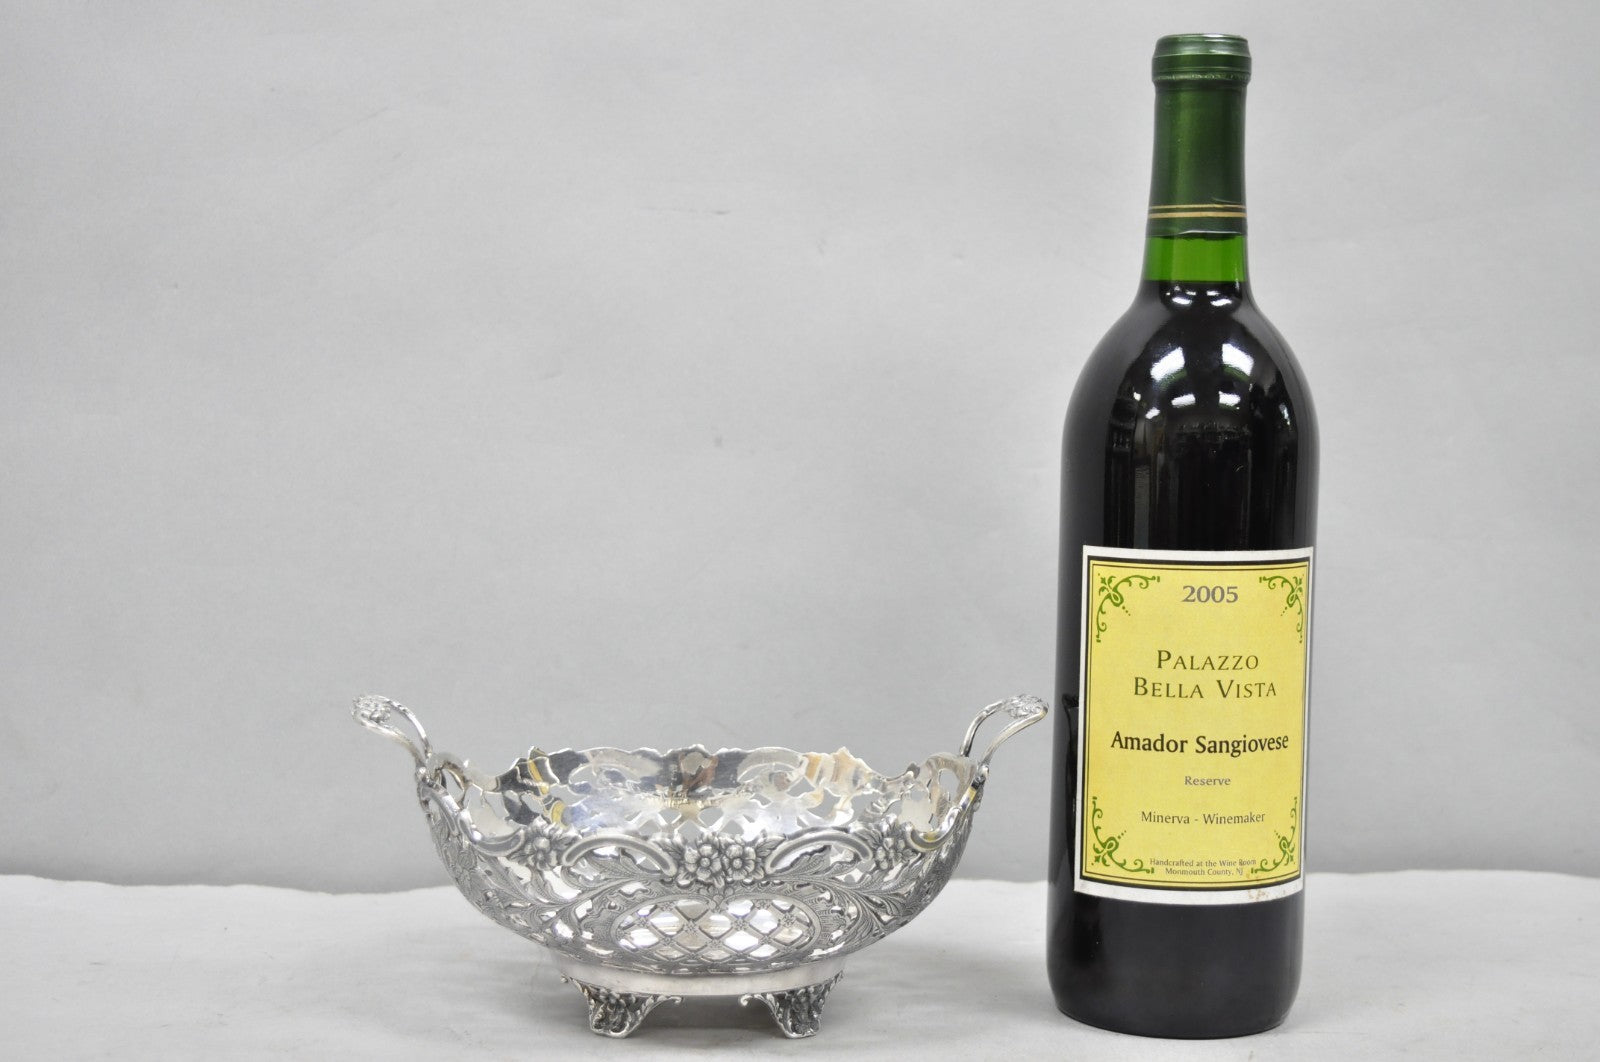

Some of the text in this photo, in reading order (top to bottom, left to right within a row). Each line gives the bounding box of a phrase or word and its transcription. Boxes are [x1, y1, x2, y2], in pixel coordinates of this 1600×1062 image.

[1182, 585, 1239, 603] 2005
[1156, 650, 1259, 671] PALAZZO
[1133, 677, 1277, 699] BELLA VISTA
[1110, 731, 1289, 758] Amador Sangiovese
[1184, 775, 1231, 786] Reserve
[1141, 811, 1190, 824] Minerva
[1203, 812, 1266, 825] Winemaker
[1150, 858, 1194, 867] Handcrafted
[1205, 859, 1217, 867] the
[1219, 859, 1237, 867] Wine
[1238, 858, 1257, 867] Room
[1165, 867, 1205, 876] Monmouth
[1235, 868, 1244, 876] NJ
